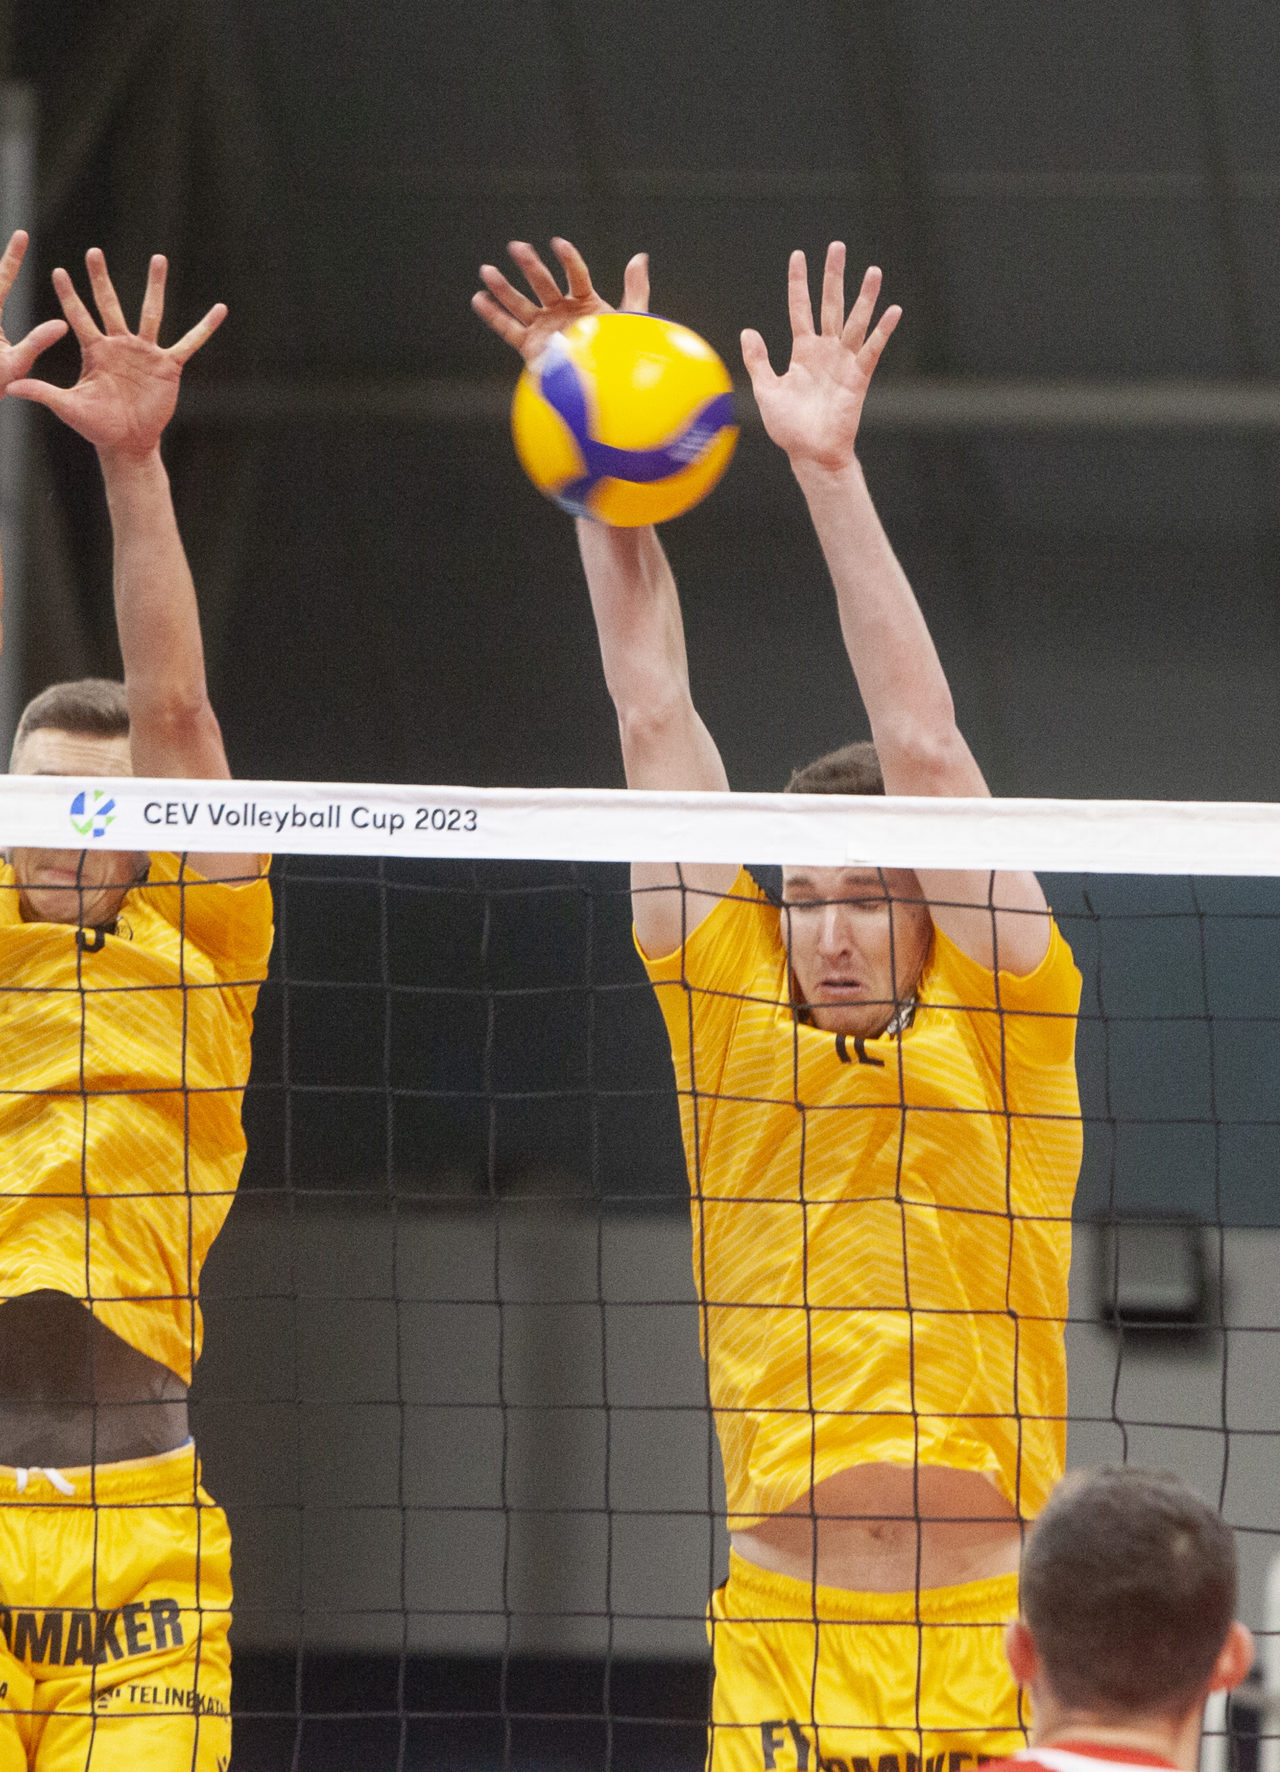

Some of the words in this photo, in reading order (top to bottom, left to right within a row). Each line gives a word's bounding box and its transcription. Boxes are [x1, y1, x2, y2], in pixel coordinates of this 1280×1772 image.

[143, 801, 200, 826] CEV
[209, 803, 341, 833] Volleyball
[350, 806, 406, 835] Cup
[415, 807, 478, 832] 2023
